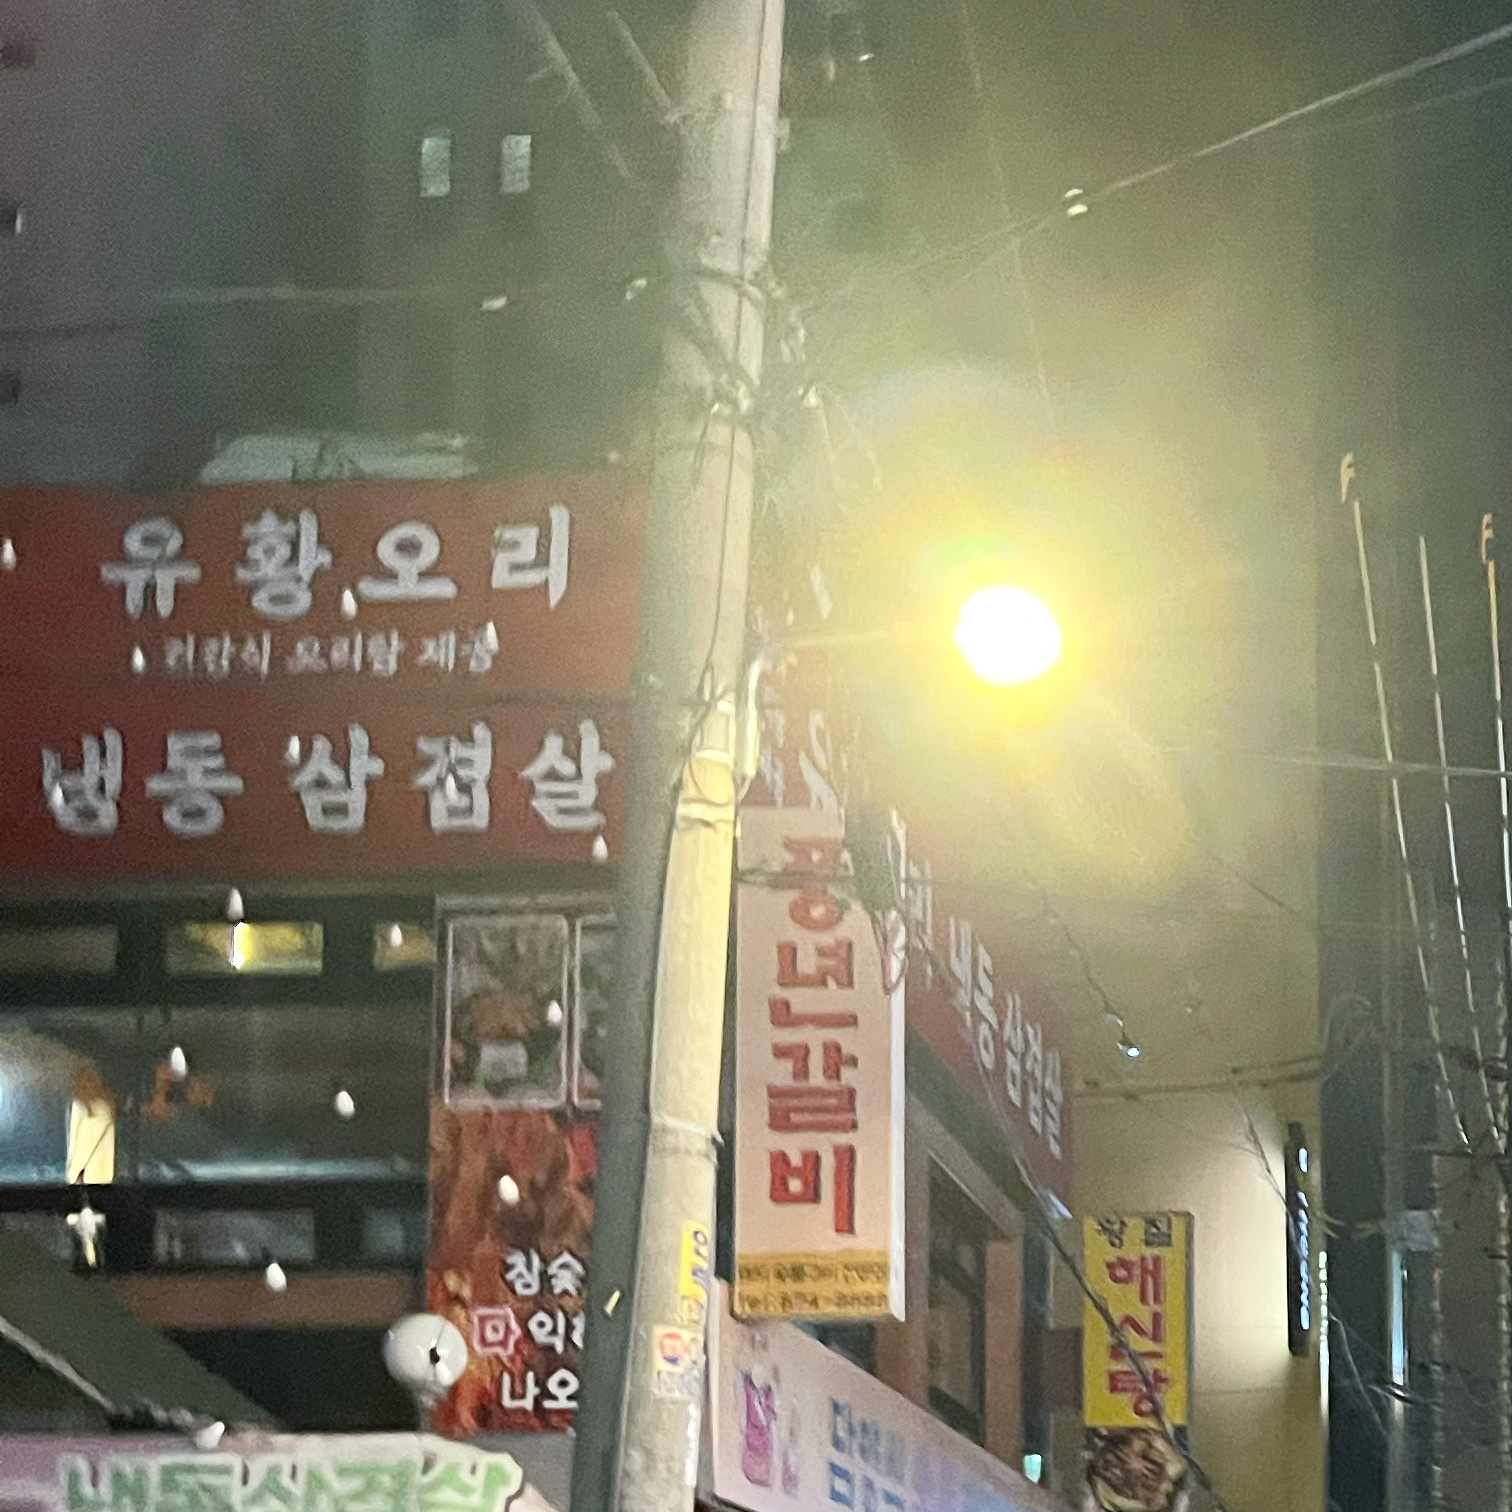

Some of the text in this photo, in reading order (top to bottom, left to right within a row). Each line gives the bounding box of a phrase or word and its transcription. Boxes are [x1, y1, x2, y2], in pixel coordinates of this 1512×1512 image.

[101, 503, 571, 619] 유황오리
[42, 720, 617, 837] 냉동 삼겹살
